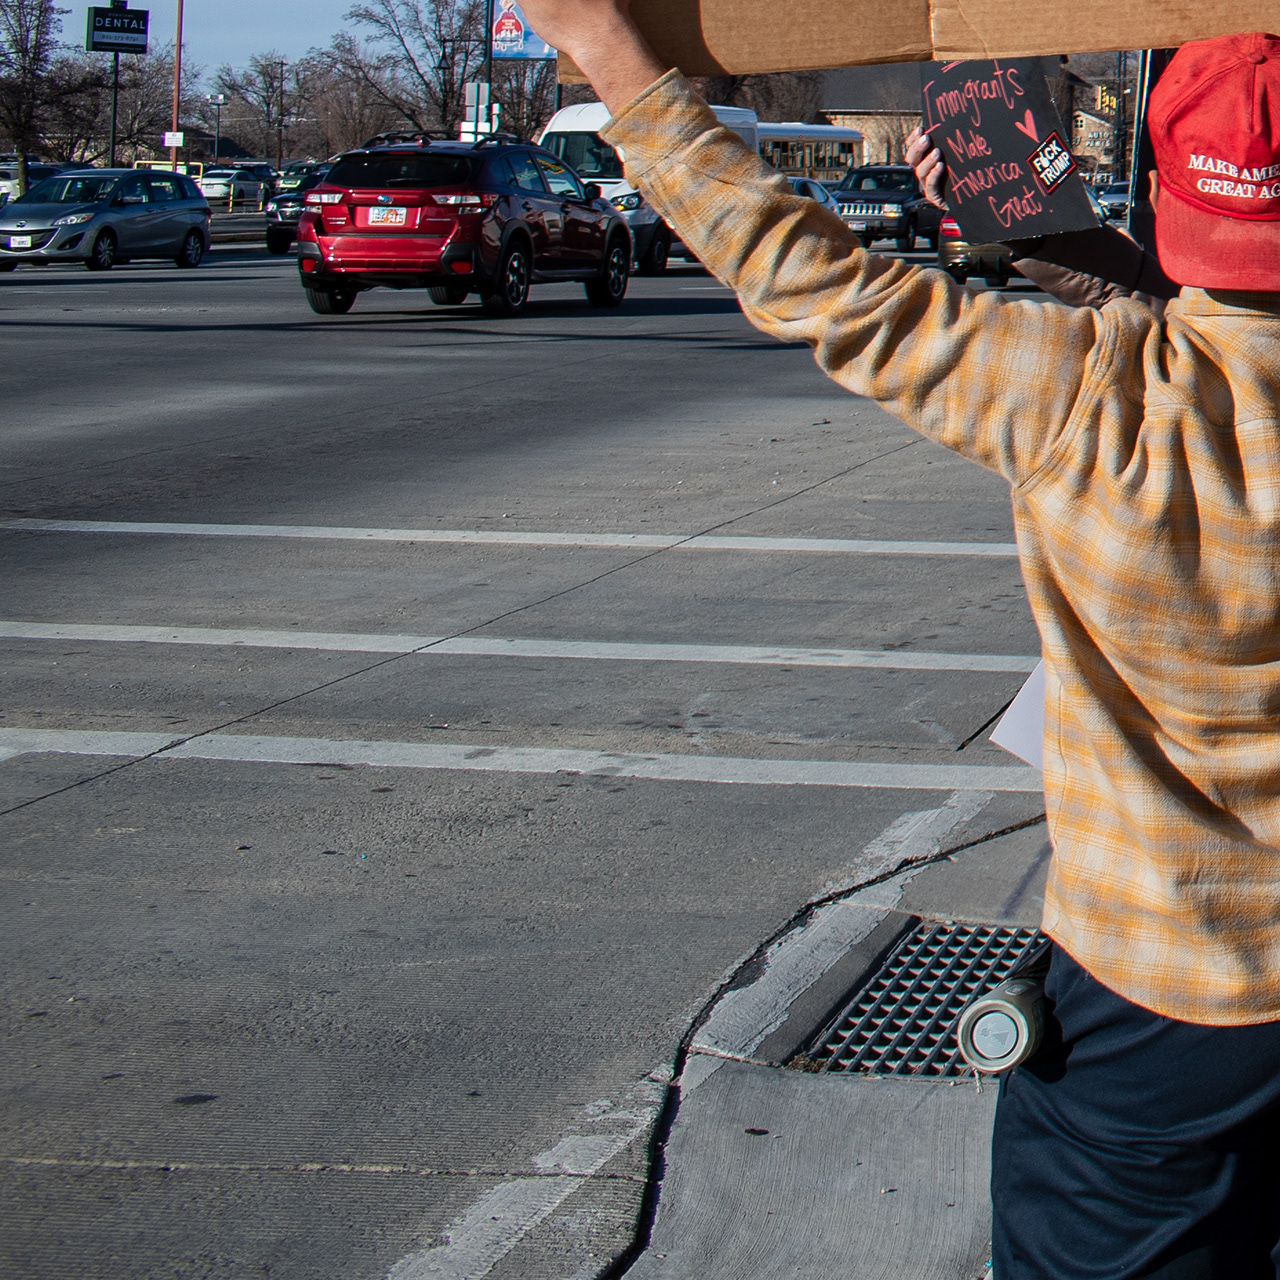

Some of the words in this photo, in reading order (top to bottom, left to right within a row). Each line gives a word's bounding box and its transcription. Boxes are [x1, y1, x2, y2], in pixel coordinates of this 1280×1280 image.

[95, 17, 146, 30] DENTAL
[922, 59, 1025, 134] Immigrants
[946, 128, 992, 163] Make
[1040, 152, 1071, 186] TRUMP
[1187, 153, 1239, 178] MAKE
[946, 162, 1024, 205] America
[1196, 177, 1257, 199] GREAT
